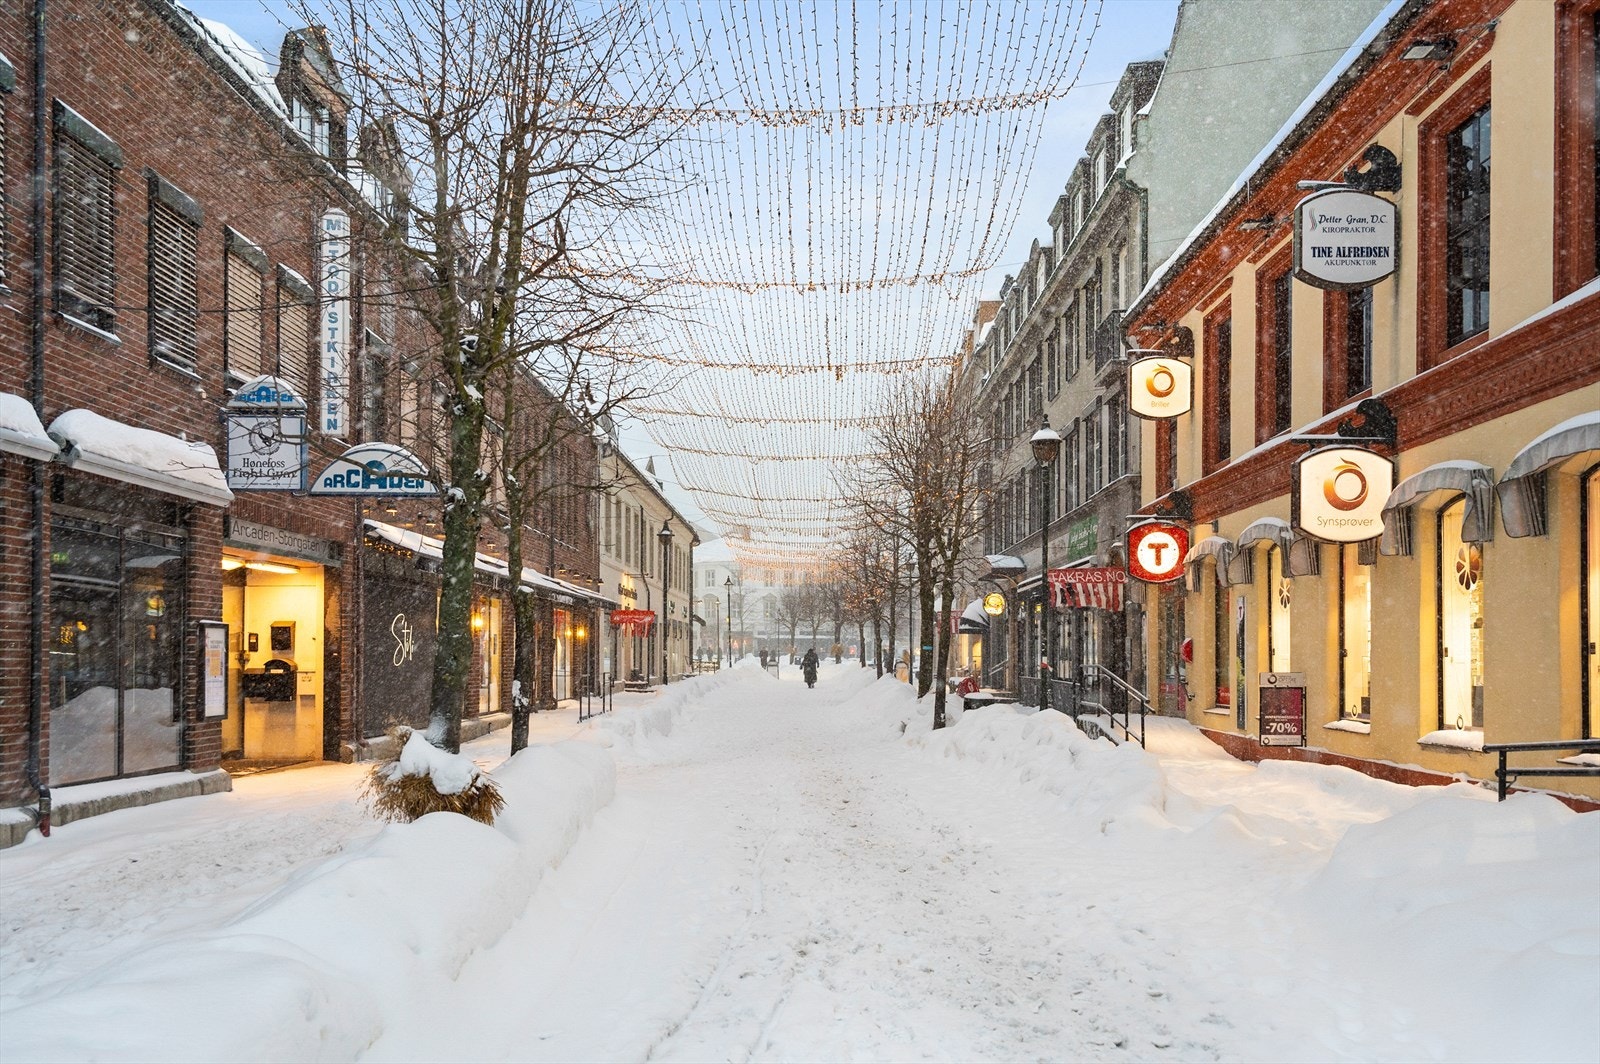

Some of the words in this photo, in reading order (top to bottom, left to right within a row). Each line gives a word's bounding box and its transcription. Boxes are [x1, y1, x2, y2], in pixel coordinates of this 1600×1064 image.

[1310, 246, 1333, 258] TINE
[1335, 246, 1390, 258] ALFREDSEN
[242, 458, 286, 468] Hønefoss
[1316, 515, 1374, 528] Synsprøver
[231, 519, 320, 552] Arcaden-Storgaten
[1147, 542, 1169, 567] T
[1050, 570, 1126, 583] TAKRAS.NO
[1265, 722, 1298, 733] -70%
